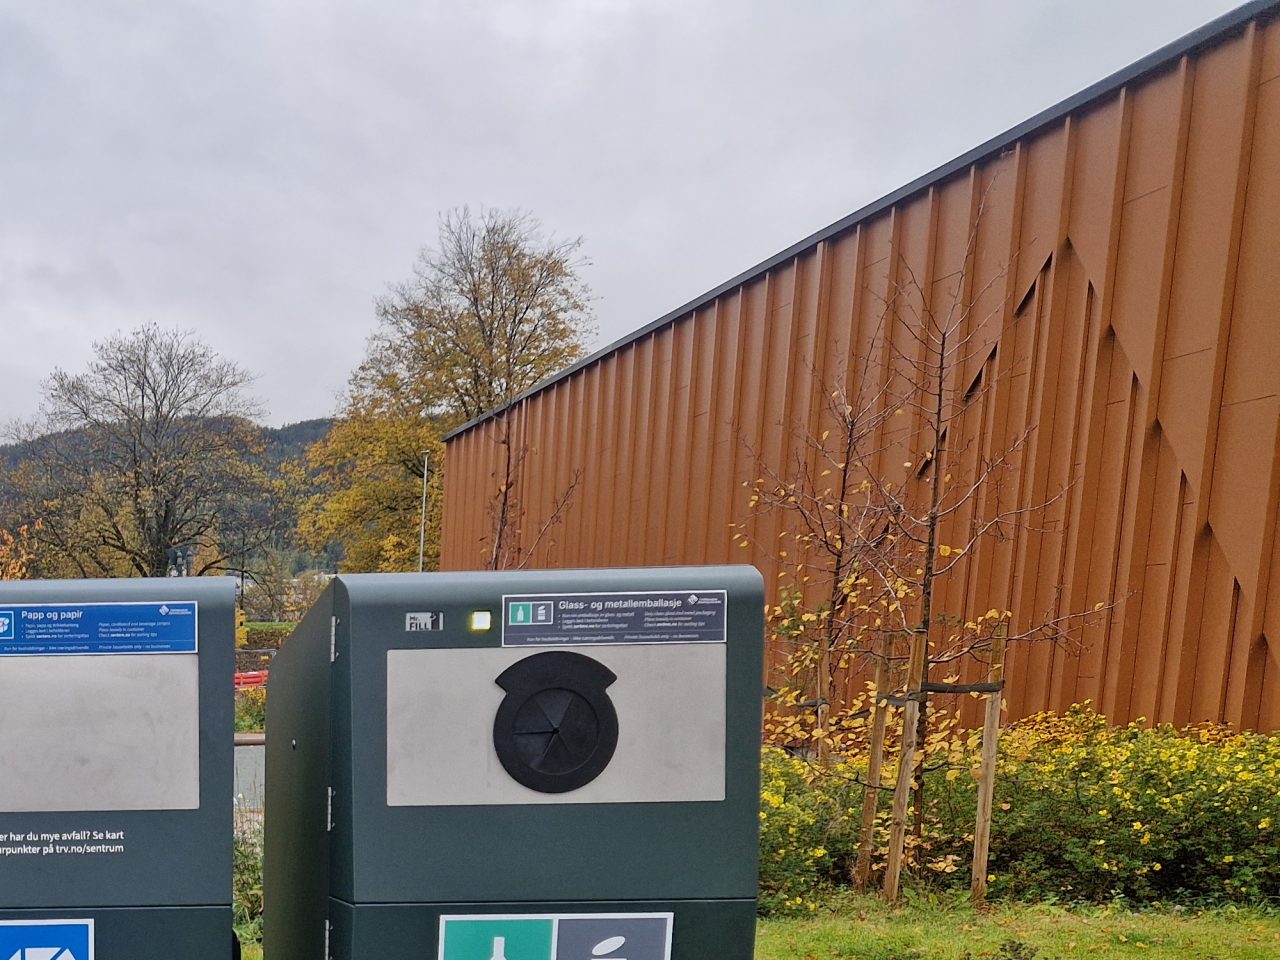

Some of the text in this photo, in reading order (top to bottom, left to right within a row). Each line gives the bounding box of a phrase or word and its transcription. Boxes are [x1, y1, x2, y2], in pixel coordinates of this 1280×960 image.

[558, 598, 682, 611] Glass- og metallemballasje
[21, 609, 83, 620] Papp og papir
[409, 622, 429, 630] FILL
[9, 831, 25, 842] har
[26, 831, 39, 841] du
[40, 832, 60, 842] mye
[61, 830, 91, 840] avfall?
[92, 830, 104, 840] Se
[105, 829, 124, 840] kart
[42, 843, 54, 855] på
[55, 843, 124, 854] trv.no/sentrum
